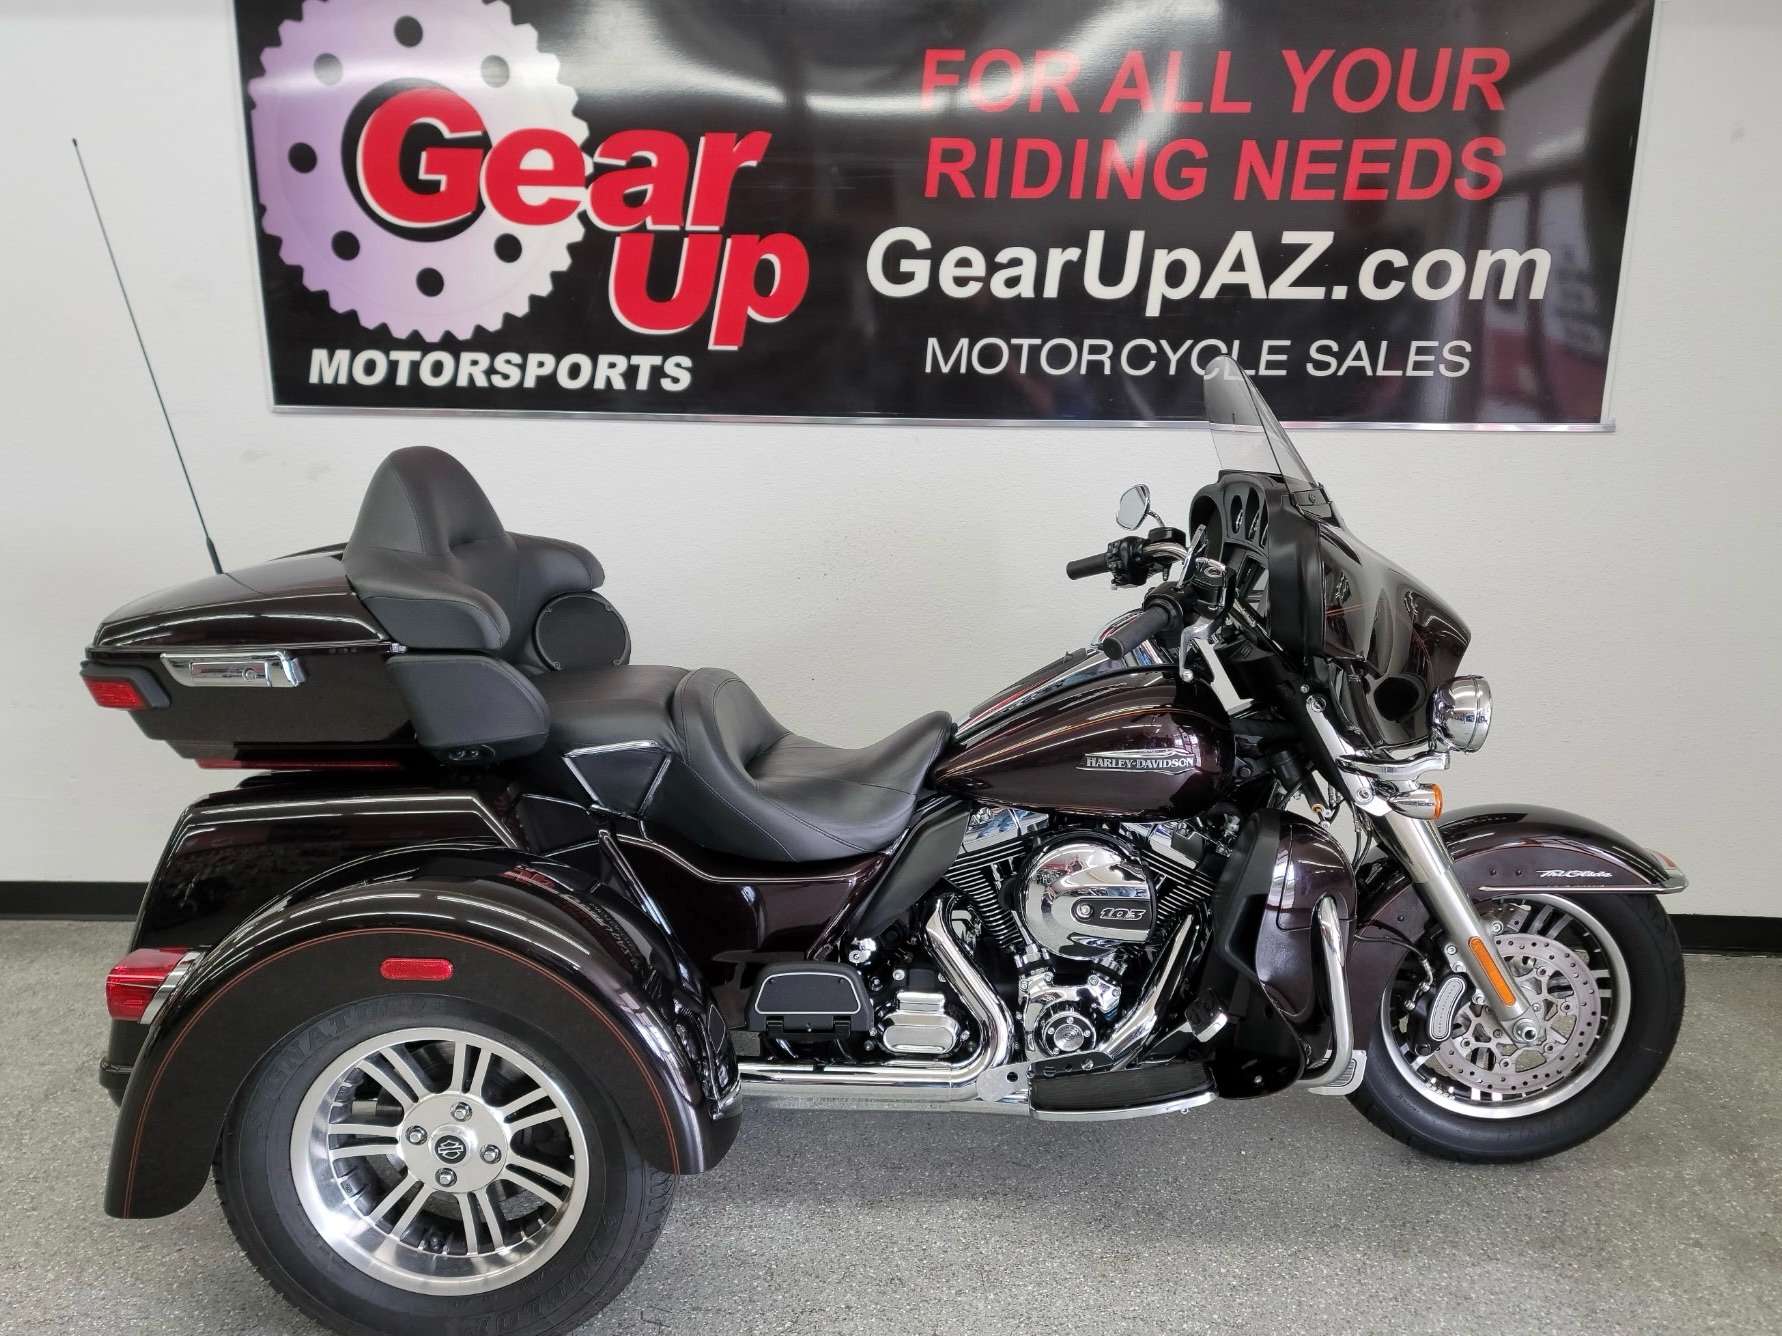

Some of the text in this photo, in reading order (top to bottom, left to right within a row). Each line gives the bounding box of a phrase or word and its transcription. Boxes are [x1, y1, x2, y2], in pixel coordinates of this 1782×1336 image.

[920, 47, 1511, 113] FOR ALL YOUR
[355, 87, 772, 232] Gear
[924, 136, 1506, 201] RIDING NEEDS
[608, 232, 810, 351] Up
[865, 226, 1552, 317] GearUpAZ.com
[307, 348, 693, 391] MOTORSPORTS
[924, 337, 1472, 380] MOTORCYCLE SALES
[1086, 756, 1194, 769] HARLEY-DAVIDSON
[1099, 907, 1147, 920] 103
